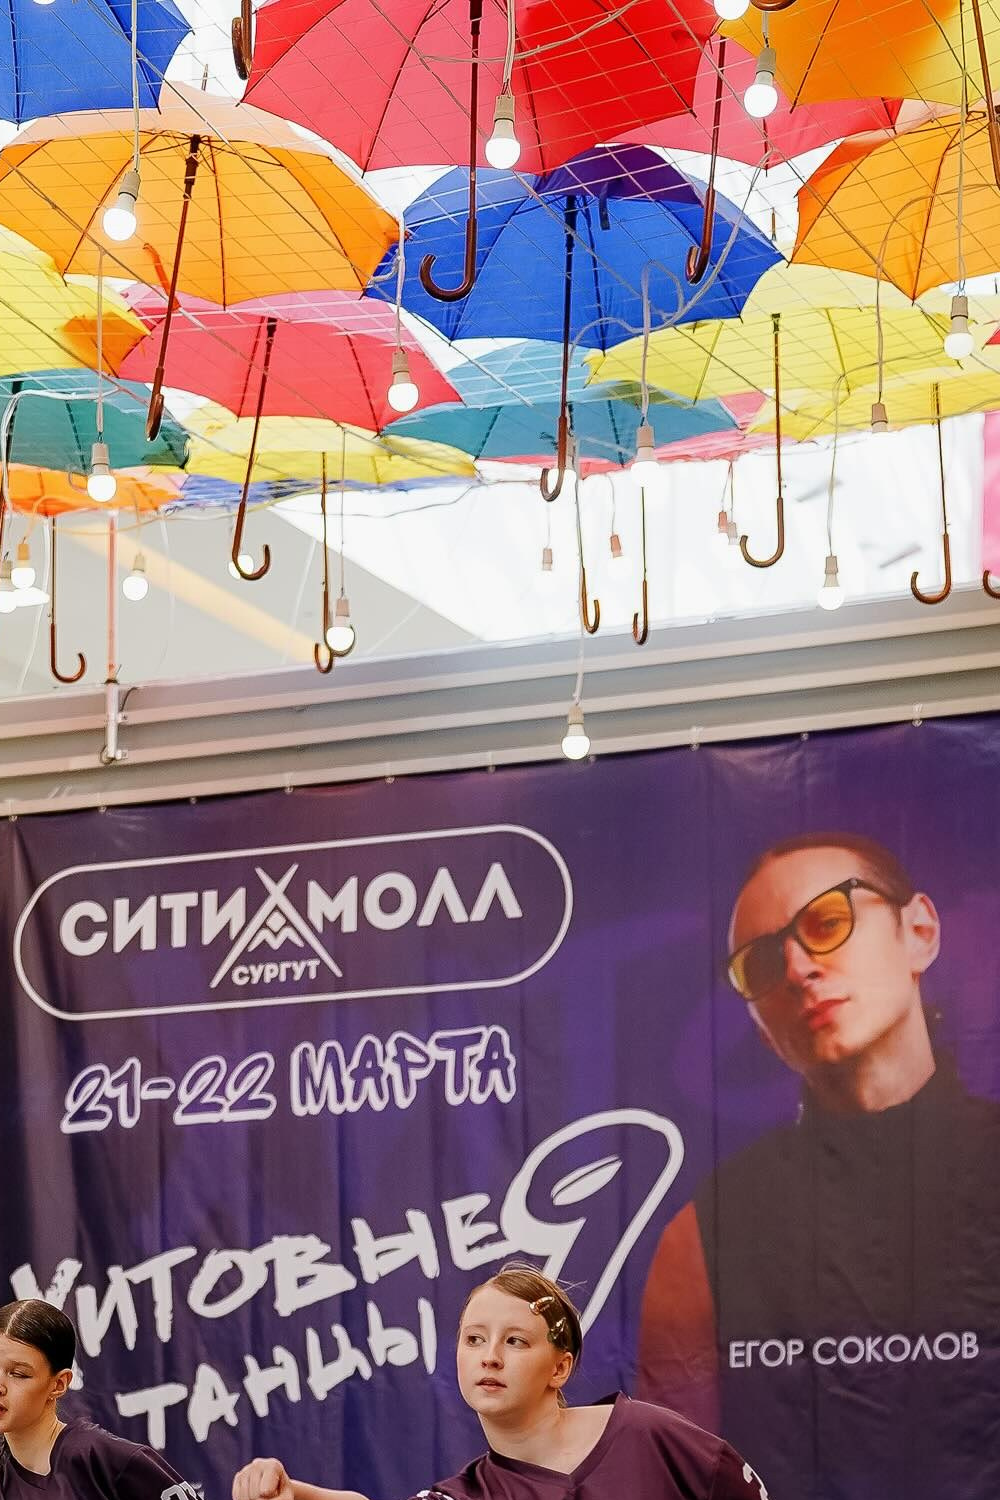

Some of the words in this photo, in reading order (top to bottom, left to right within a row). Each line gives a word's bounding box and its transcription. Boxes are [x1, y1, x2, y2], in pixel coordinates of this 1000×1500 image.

[60, 886, 246, 956] СИТИ
[307, 861, 524, 934] МОЛЛ
[231, 957, 321, 985] СУРГУТ
[60, 1051, 278, 1133] 21-22
[289, 1025, 517, 1117] МАРТА
[115, 1298, 437, 1449] ТАНЦЫ
[728, 1338, 804, 1368] ЕГОР
[812, 1331, 980, 1365] СОКОЛОВ
